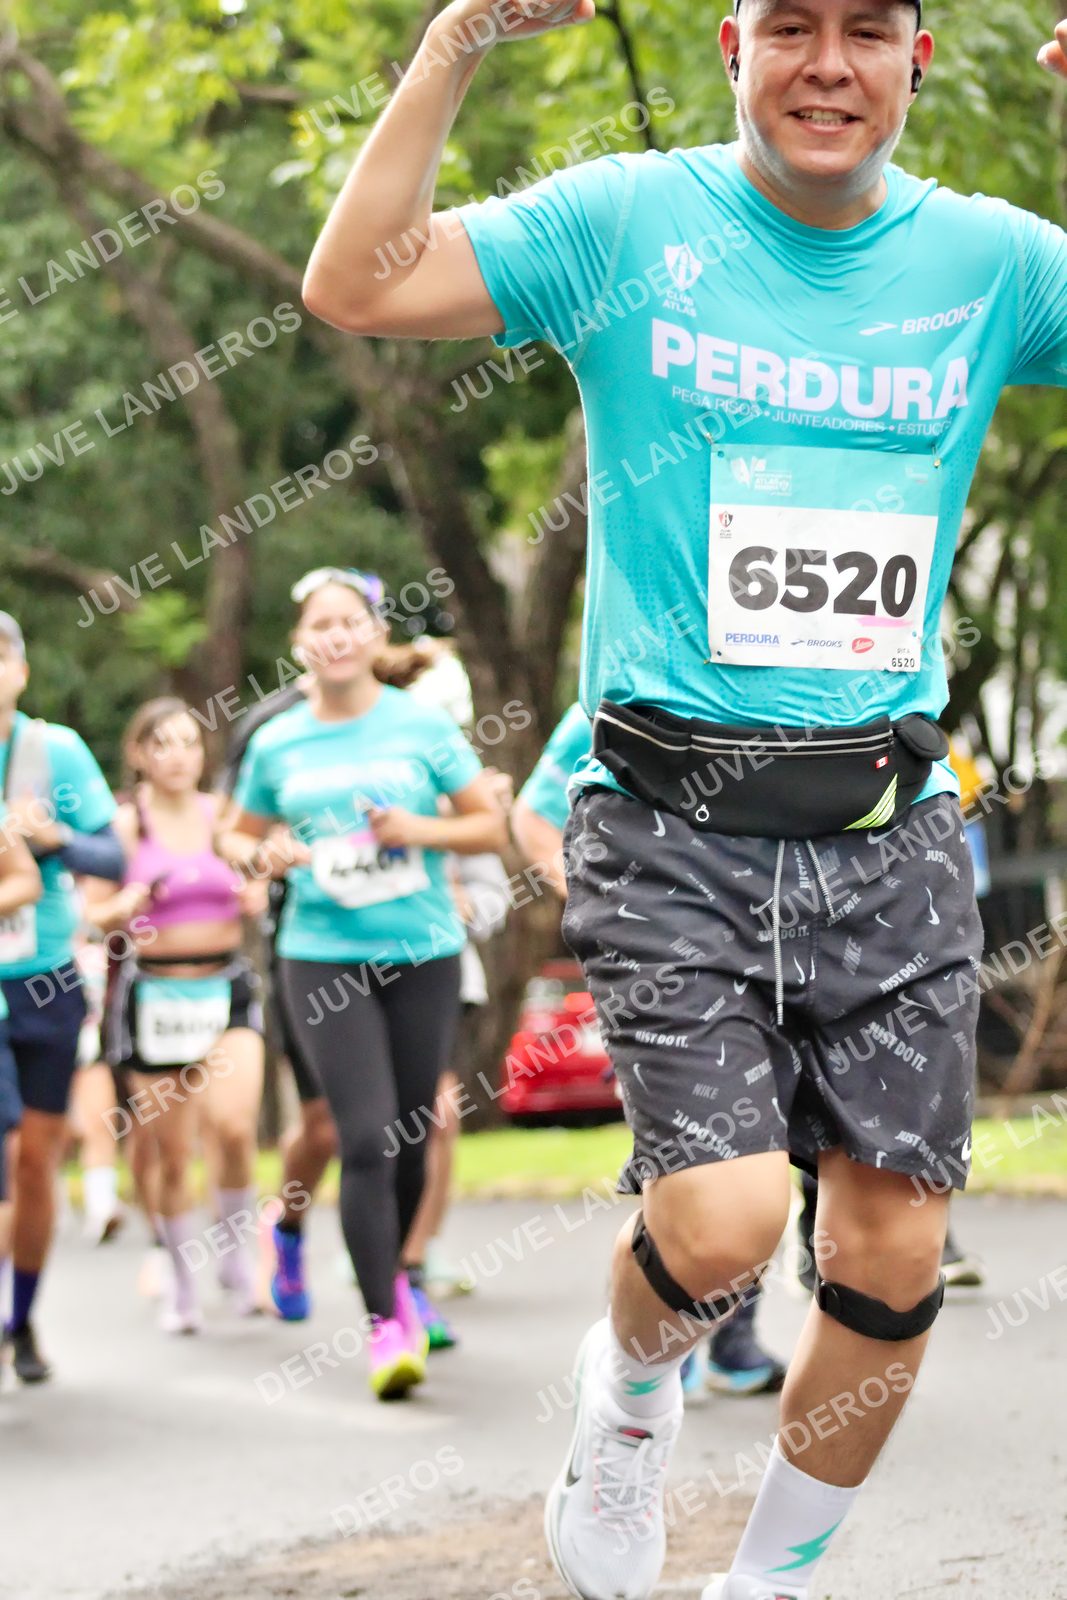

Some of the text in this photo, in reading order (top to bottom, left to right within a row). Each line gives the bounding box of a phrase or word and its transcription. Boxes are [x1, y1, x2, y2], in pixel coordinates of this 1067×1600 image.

[662, 299, 697, 317] ATLAS
[901, 298, 986, 336] BROOKS
[651, 317, 969, 420] PERDURA
[672, 385, 711, 408] PEGA
[715, 398, 761, 418] PISOS
[772, 409, 888, 433] JUNTEADORES
[728, 545, 918, 618] 6520
[725, 632, 780, 645] PERDURA
[806, 639, 843, 648] BROOKS
[891, 657, 915, 669] 6520
[843, 899, 856, 915] DO
[781, 927, 796, 940] DO
[798, 925, 811, 938] IT.
[879, 952, 930, 995] JUST DO IT.
[658, 1034, 676, 1047] DO
[675, 1035, 690, 1049] IT.
[865, 1021, 928, 1073] JUST DO IT.
[691, 1083, 720, 1101] NIKE
[686, 1121, 710, 1142] DO
[894, 1130, 922, 1147] JUST
